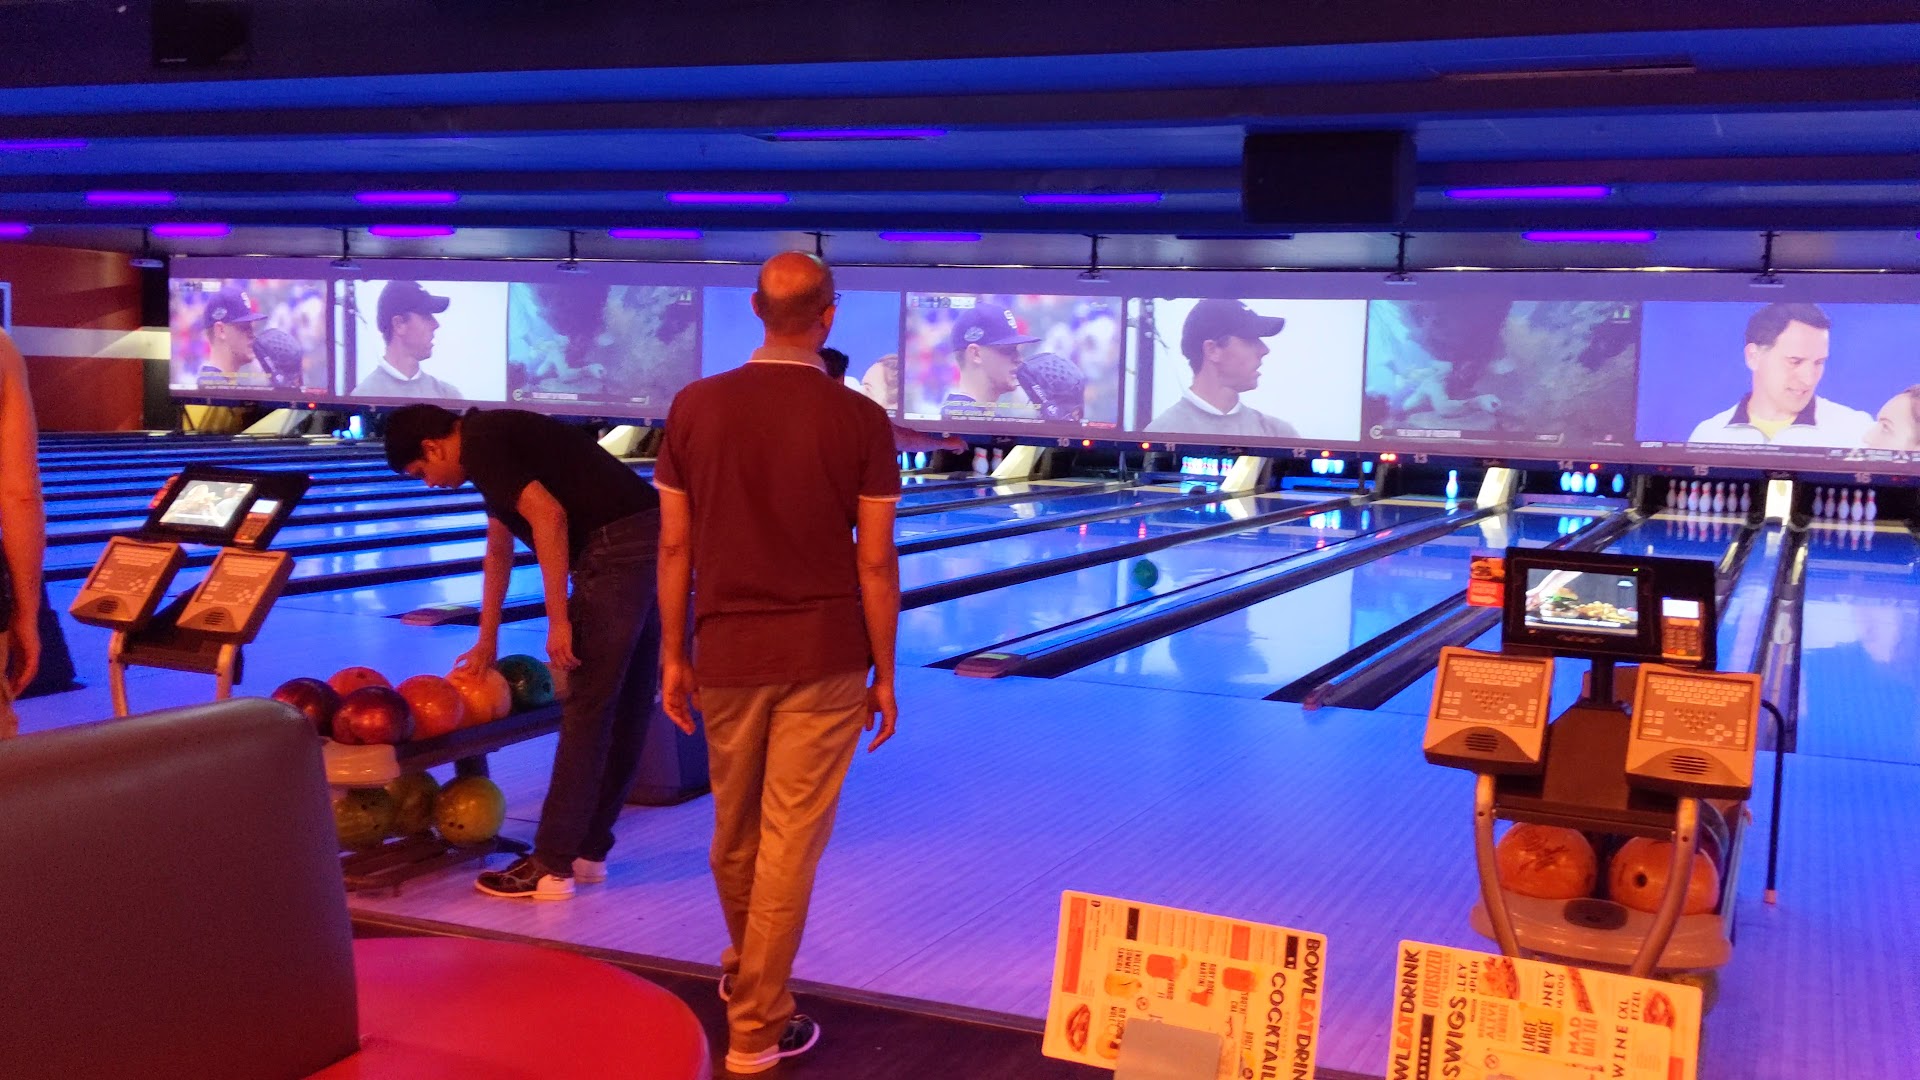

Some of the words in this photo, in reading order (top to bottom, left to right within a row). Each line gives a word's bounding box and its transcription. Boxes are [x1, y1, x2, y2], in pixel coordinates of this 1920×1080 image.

[1057, 438, 1070, 447] 10
[1165, 443, 1176, 452] 11
[1292, 449, 1307, 458] 12
[1413, 454, 1429, 464] 13
[1557, 460, 1574, 470] 14
[1692, 465, 1709, 476] 15
[1855, 472, 1872, 483] 16
[1423, 950, 1443, 1009] OVERSIZED
[1261, 972, 1286, 1080] COCKTAIL
[1442, 995, 1467, 1078] SWIGS
[1486, 1002, 1498, 1040] ALIVE
[1521, 1020, 1537, 1052] LARGE
[1537, 1018, 1553, 1055] MARGE
[1567, 1016, 1582, 1054] MAD
[1612, 1025, 1629, 1078] WINE
